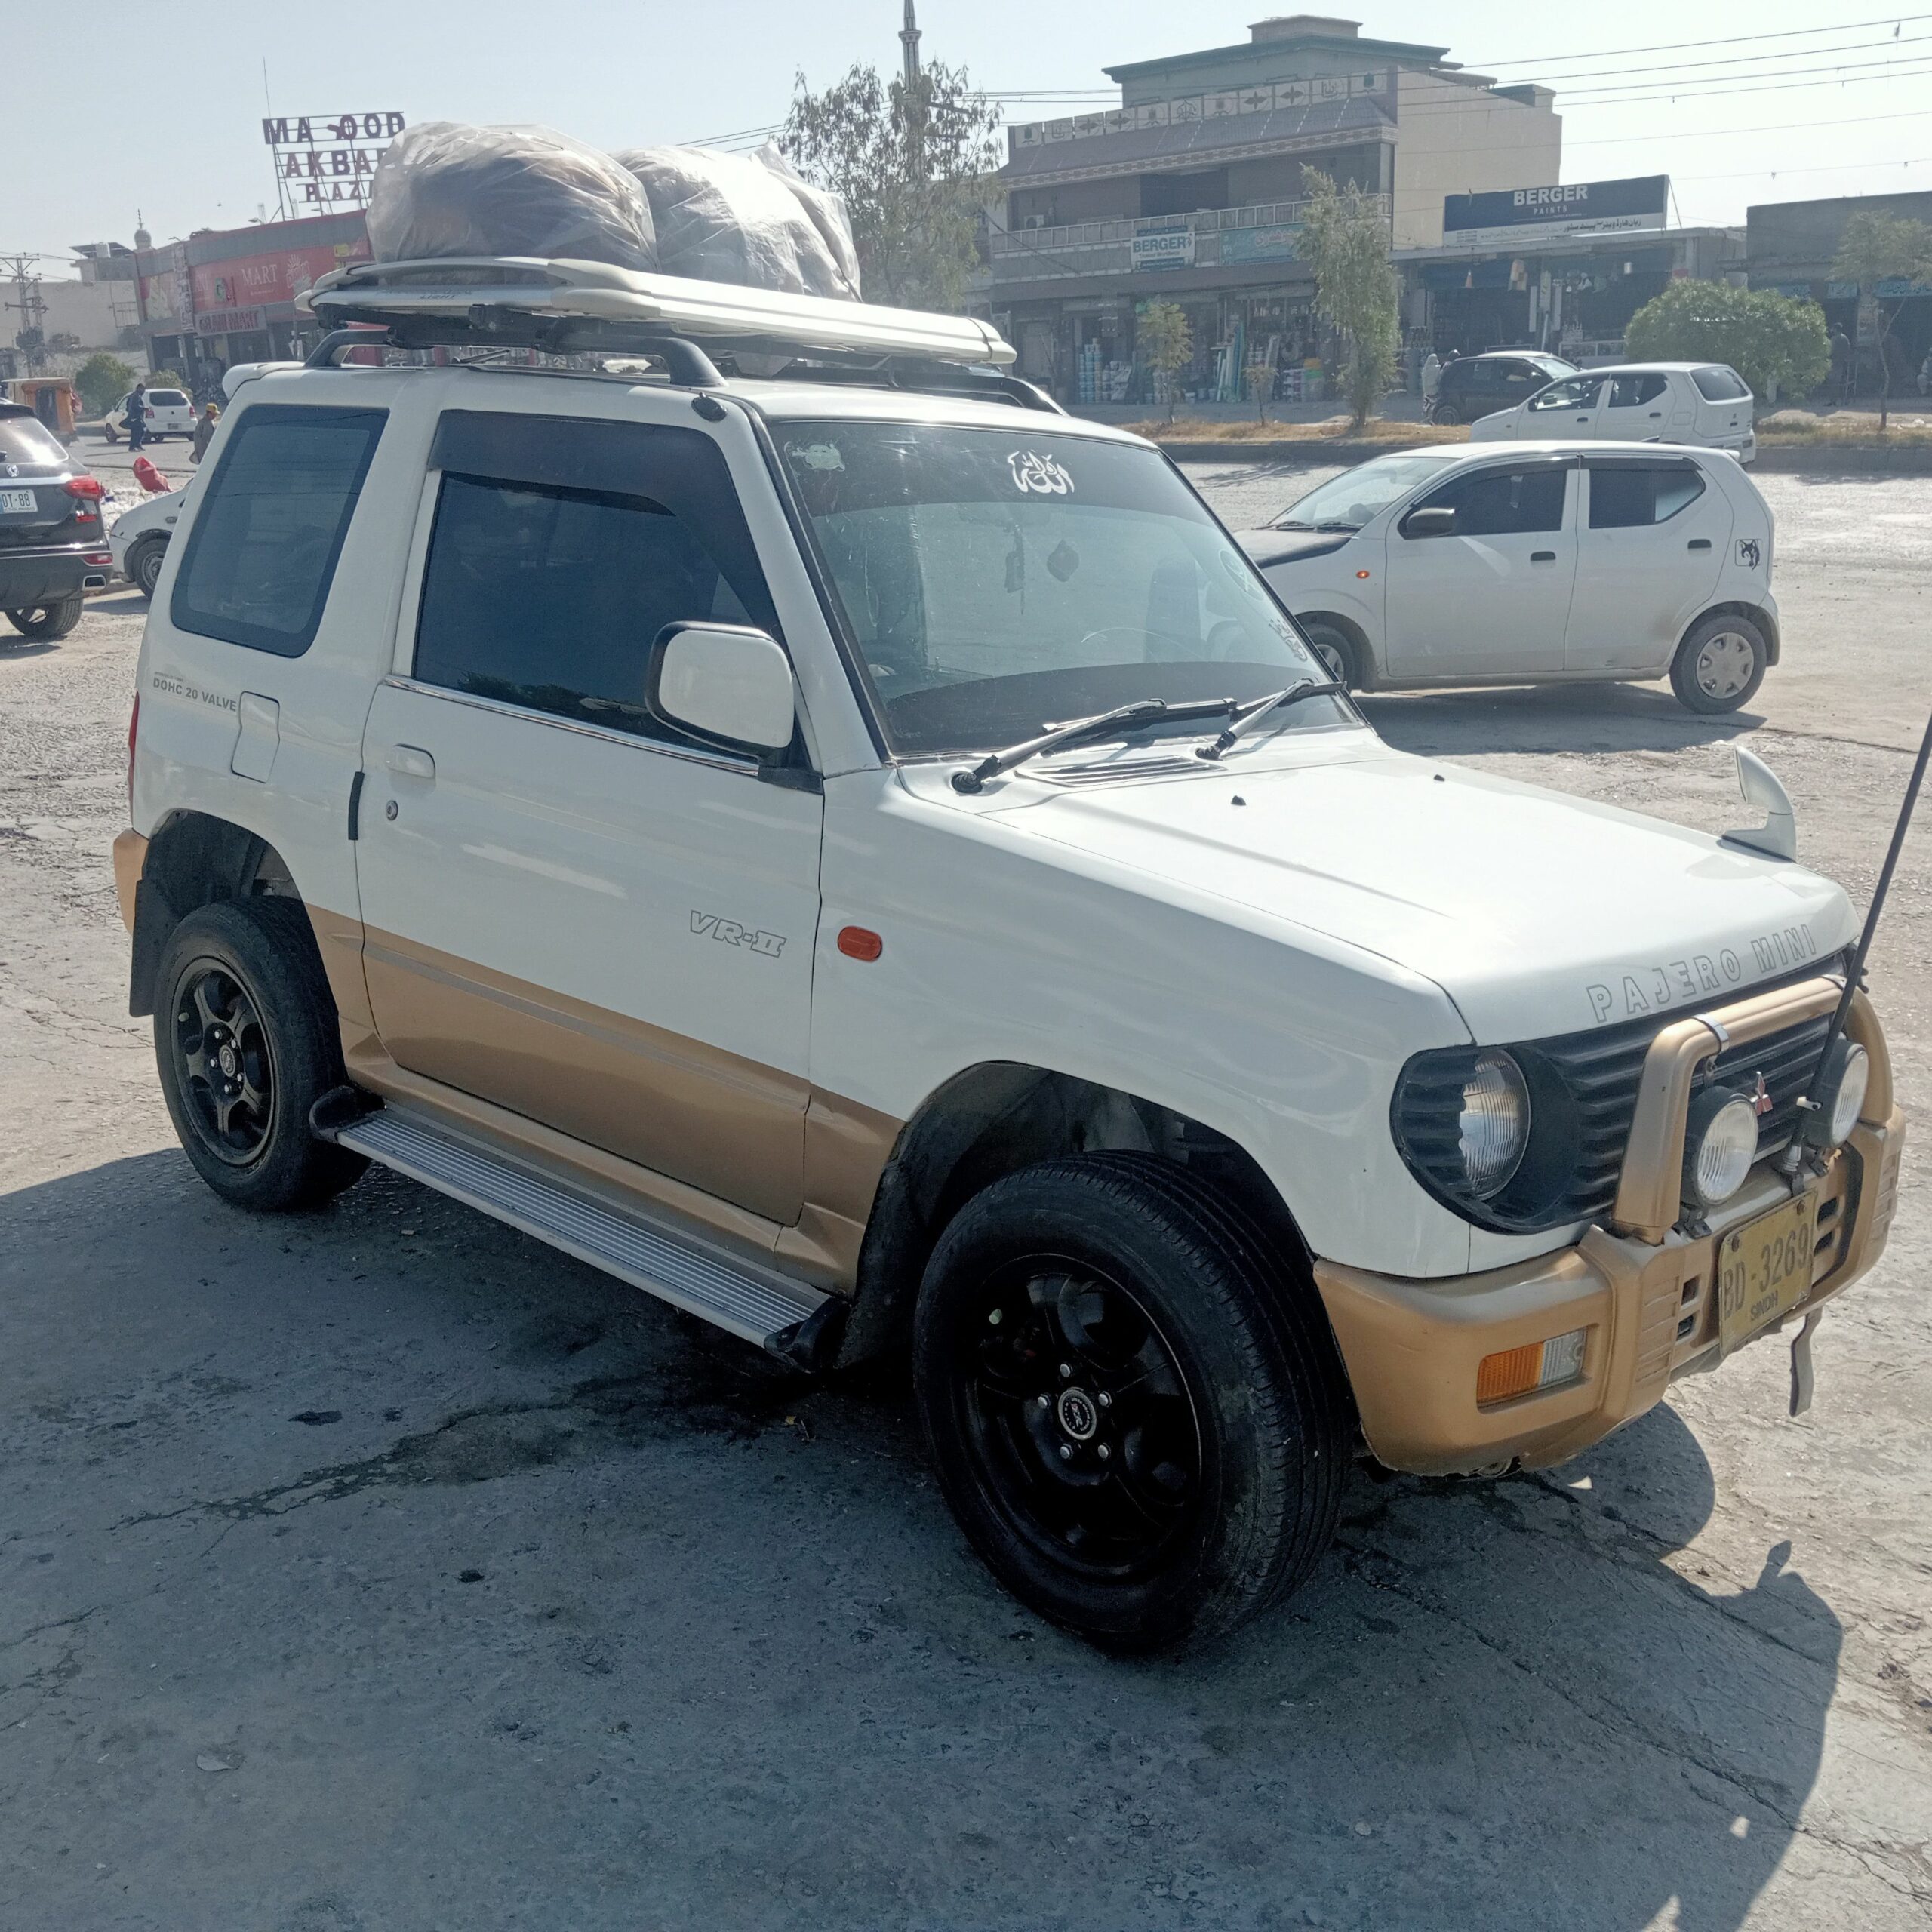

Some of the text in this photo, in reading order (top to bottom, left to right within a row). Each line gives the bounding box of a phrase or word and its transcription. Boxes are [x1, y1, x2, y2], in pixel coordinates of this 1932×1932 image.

[1514, 185, 1588, 206] BERGER
[1534, 205, 1567, 215] PAINTS
[1133, 236, 1186, 253] BERGER
[242, 264, 278, 286] MART
[153, 677, 237, 712] DOHC 20 VALVE
[1586, 924, 1818, 1023] PAJERO MINI
[1750, 1290, 1779, 1321] SINDH
